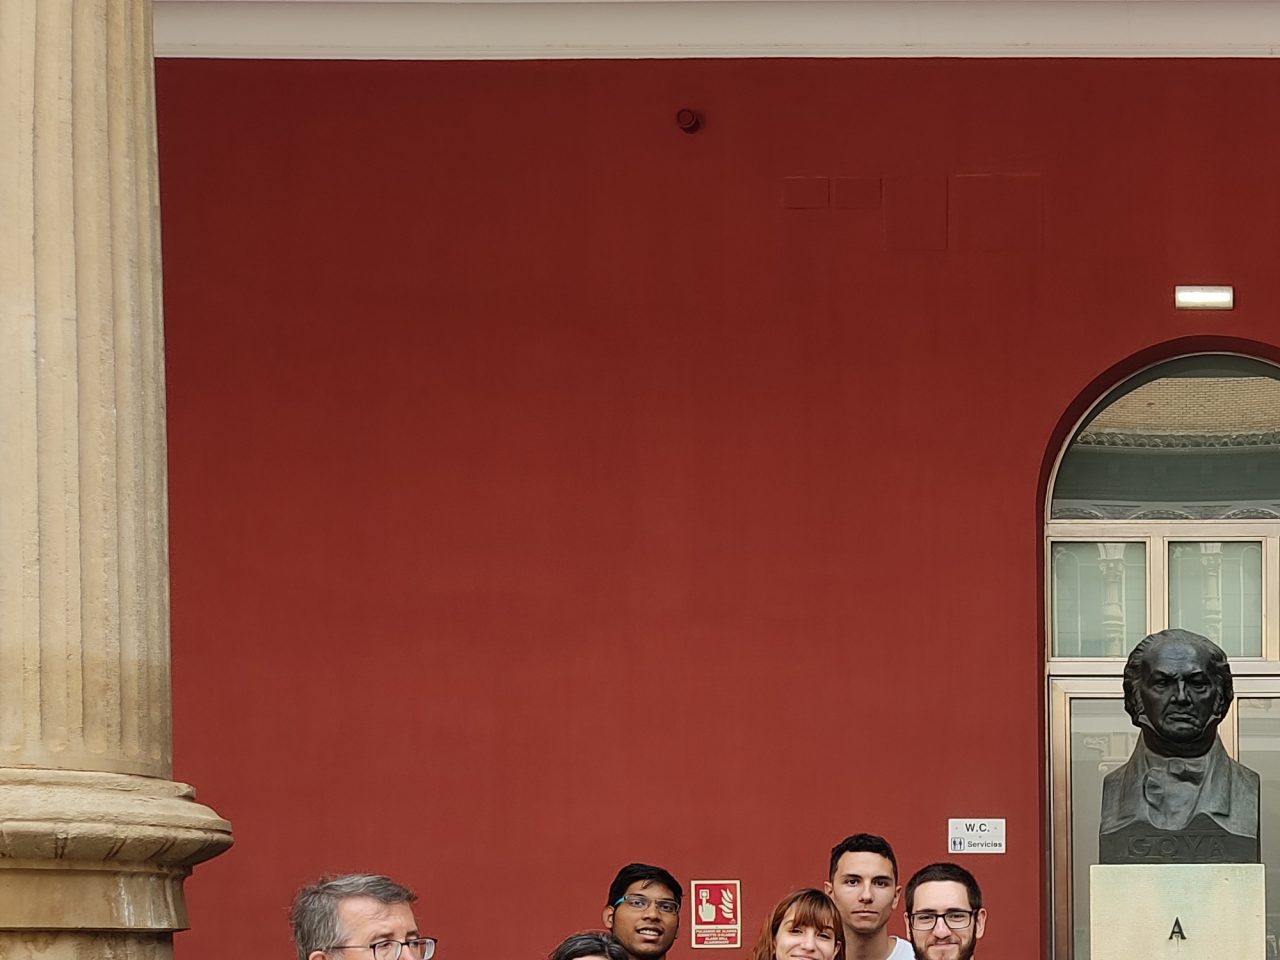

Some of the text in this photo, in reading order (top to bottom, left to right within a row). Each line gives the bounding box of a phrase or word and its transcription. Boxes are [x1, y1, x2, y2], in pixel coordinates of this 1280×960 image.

[964, 823, 990, 833] W.C.
[967, 840, 1003, 848] Servicios
[1128, 835, 1225, 857] GOYA
[1168, 917, 1187, 940] A
